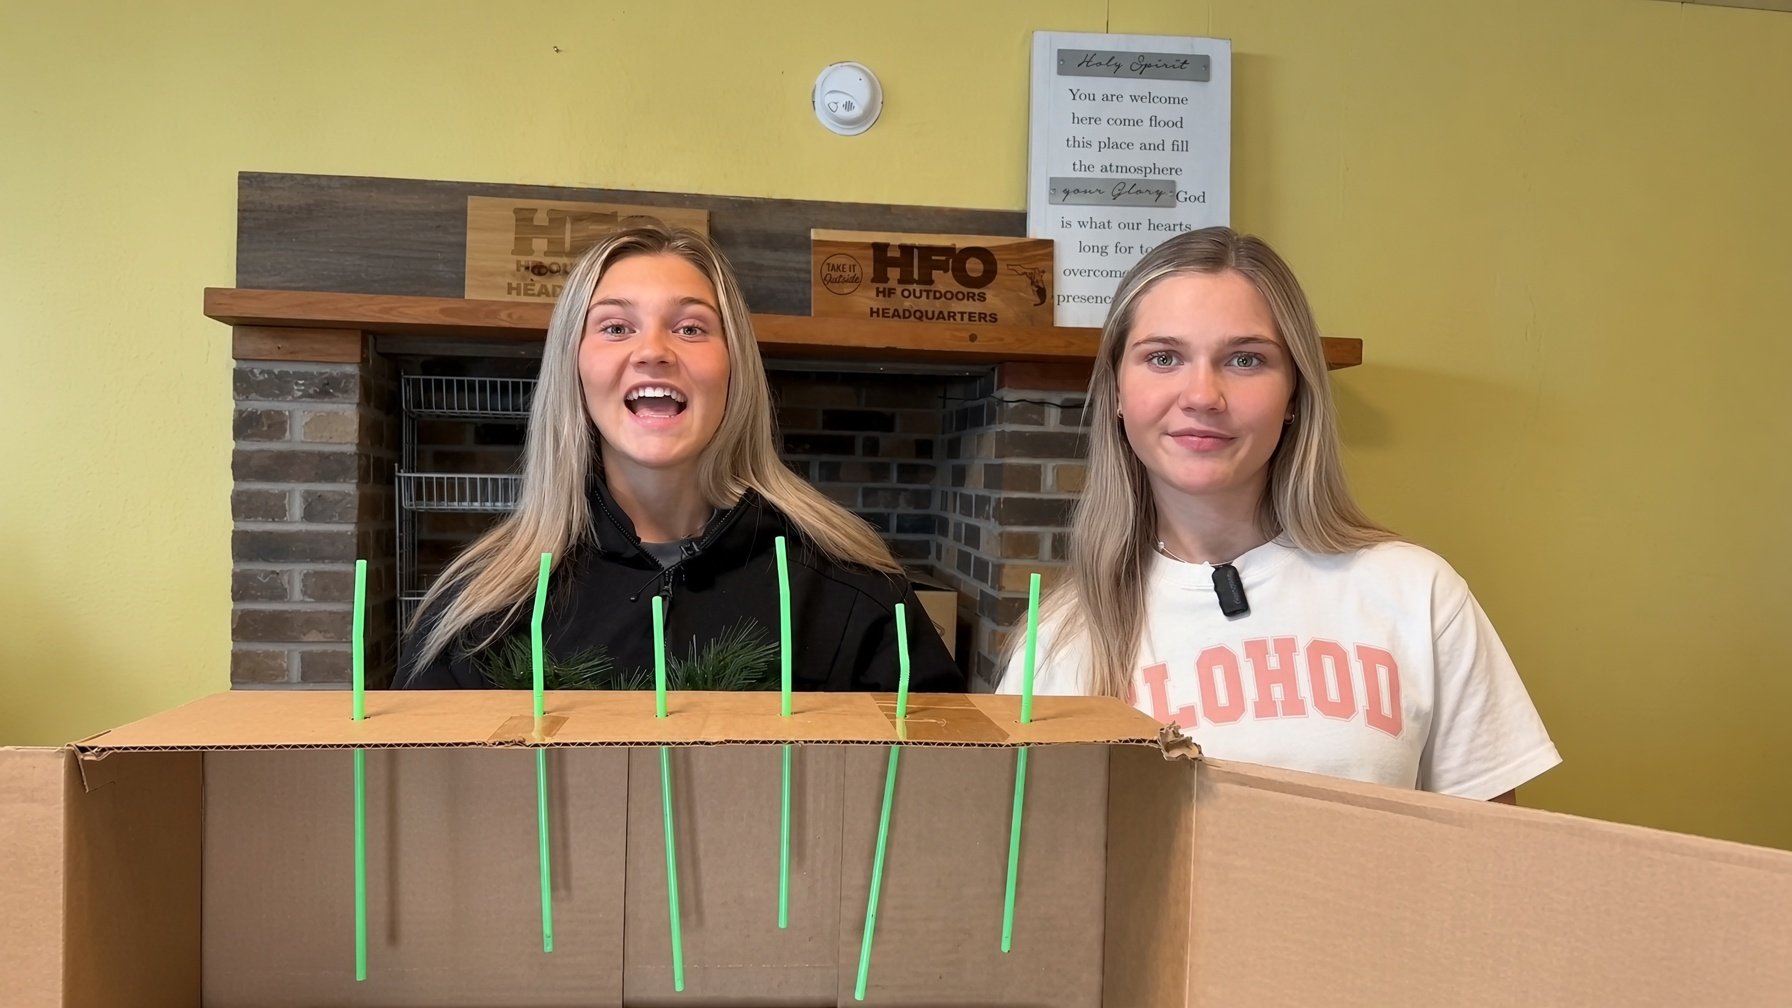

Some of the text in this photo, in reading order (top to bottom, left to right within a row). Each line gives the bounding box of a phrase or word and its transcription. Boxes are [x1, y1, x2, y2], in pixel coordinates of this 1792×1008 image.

[1077, 53, 1190, 75] Holy Spirit
[1068, 88, 1188, 105] You are welcome
[1071, 112, 1184, 129] here come flood
[1066, 136, 1189, 152] this place and fill
[1072, 160, 1183, 178] the atmosphere
[1061, 182, 1206, 204] your Glory God
[1061, 216, 1192, 232] is what our hearts
[1078, 241, 1109, 256] long
[1114, 242, 1134, 255] for
[826, 263, 857, 273] TAKE IT
[871, 242, 998, 289] HFO
[875, 287, 987, 302] HF OUTDOORS
[1057, 294, 1114, 306] presenc
[869, 307, 998, 323] HEADQUARTERS
[1126, 636, 1405, 739] LOHOD
